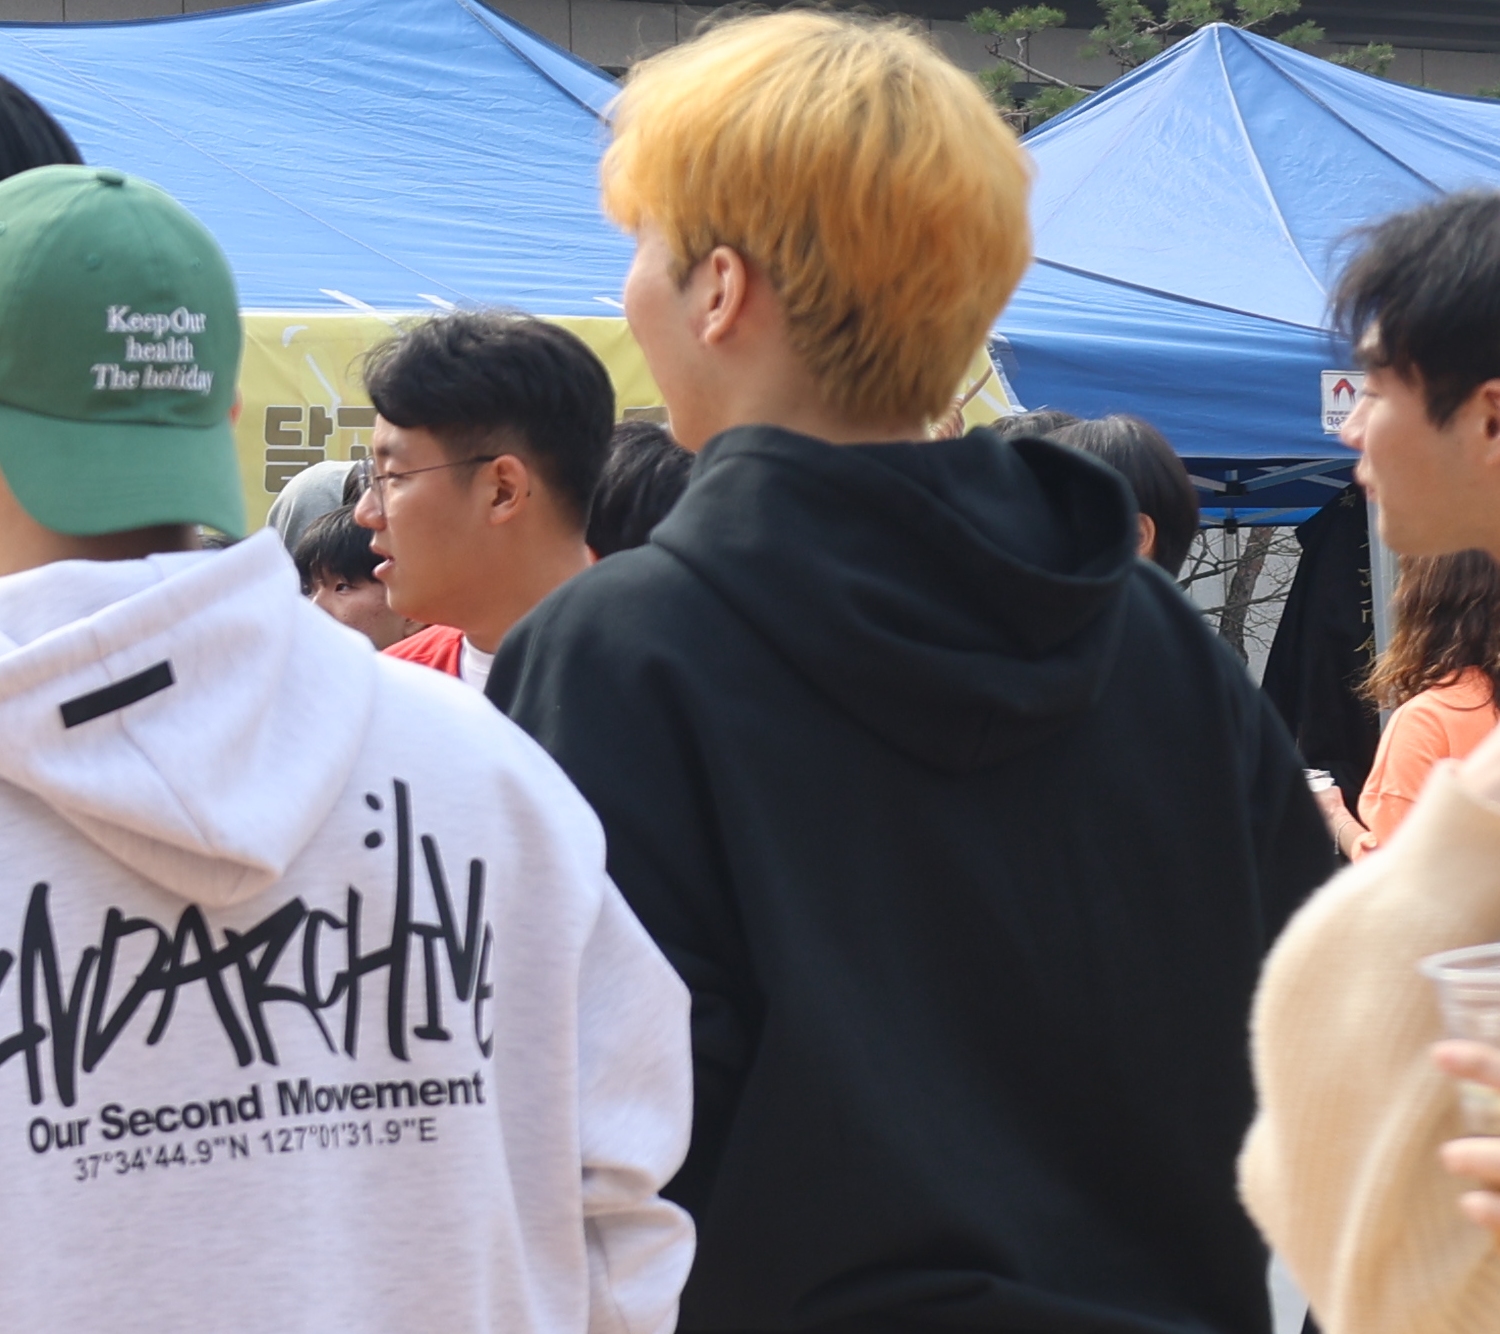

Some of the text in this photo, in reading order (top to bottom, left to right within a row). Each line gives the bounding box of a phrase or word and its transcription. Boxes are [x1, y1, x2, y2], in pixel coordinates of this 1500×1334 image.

[125, 336, 194, 362] health
[90, 363, 214, 395] The holiday
[29, 1070, 486, 1154] Our Second Movement
